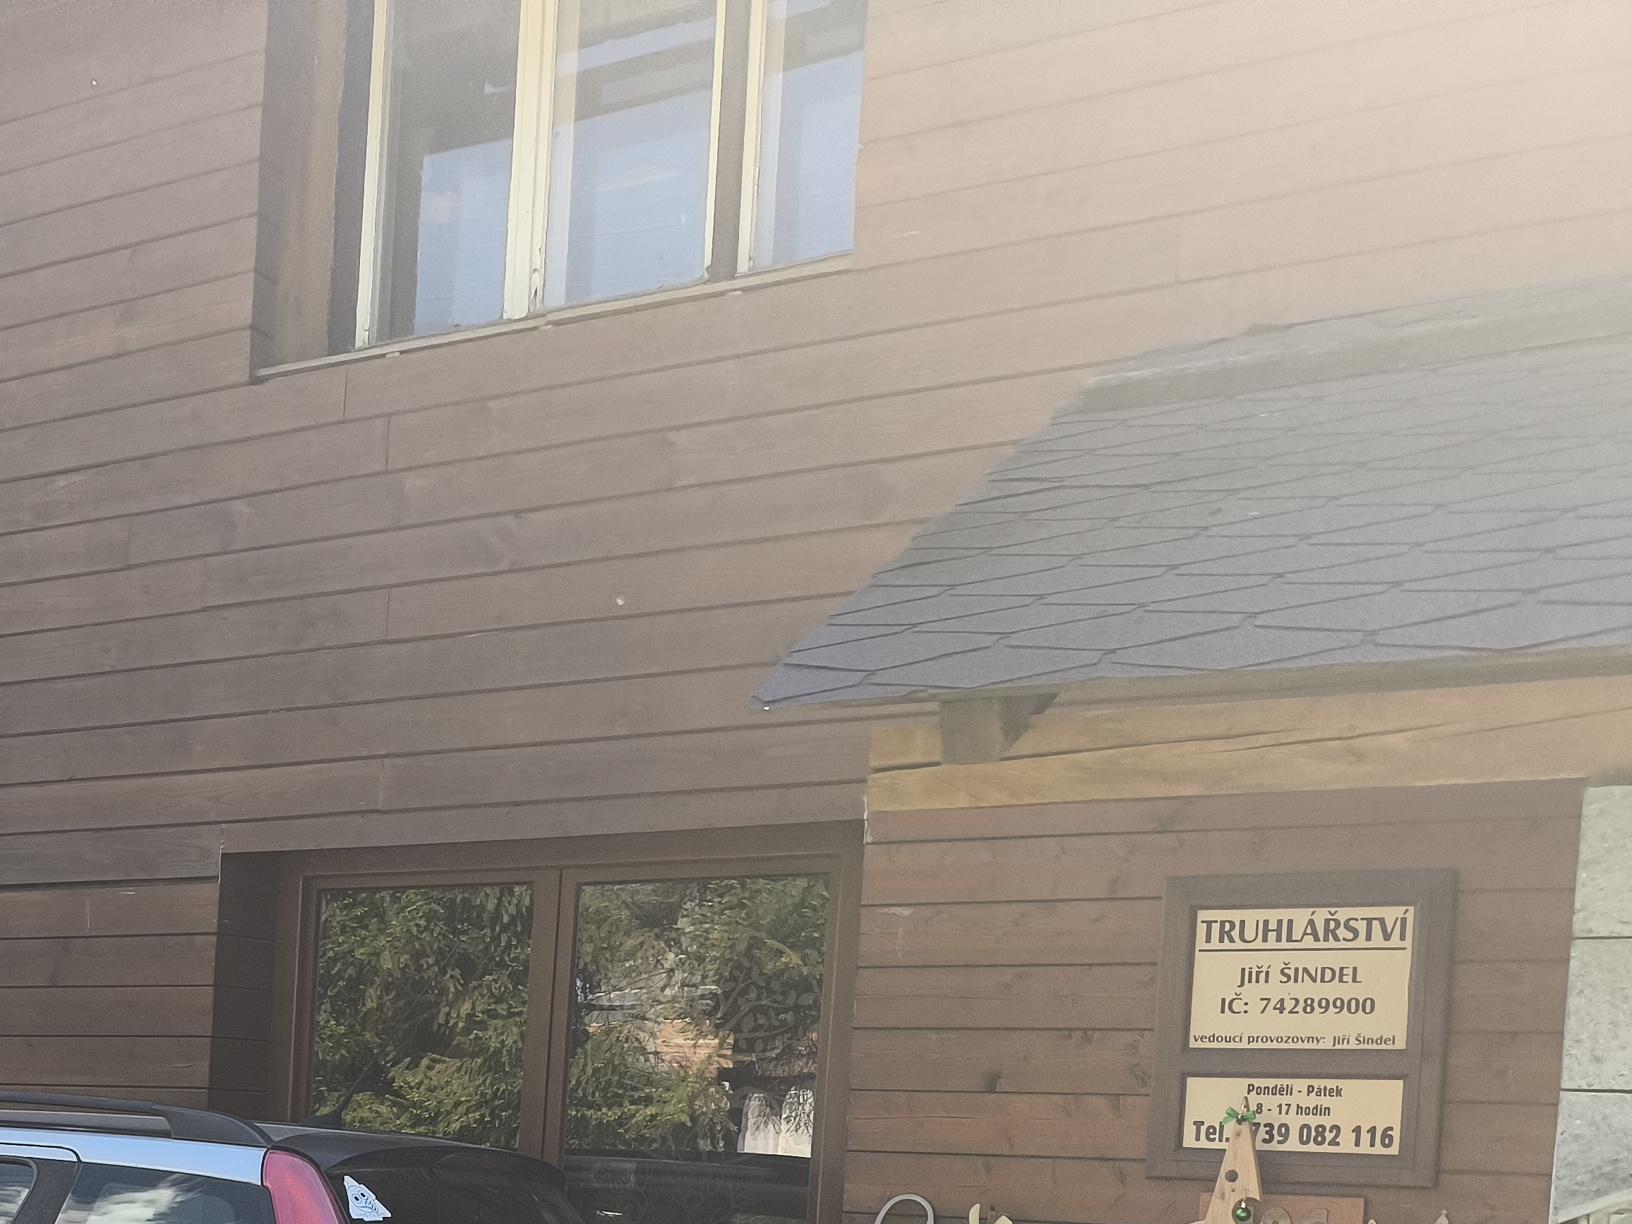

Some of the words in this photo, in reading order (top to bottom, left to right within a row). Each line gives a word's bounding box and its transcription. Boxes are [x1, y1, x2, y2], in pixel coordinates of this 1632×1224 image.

[1200, 908, 1410, 944] TRUHLÁŘSTVÍ
[1237, 964, 1271, 988] Jiří
[1278, 962, 1364, 984] ŠINDEL
[1219, 993, 1249, 1015] IČ:
[1259, 996, 1376, 1015] 74289900
[1193, 1033, 1244, 1044] vedoucí
[1247, 1036, 1327, 1046] provozovny:
[1332, 1034, 1351, 1047] Jiří
[1354, 1033, 1396, 1046] Šindel
[1247, 1083, 1294, 1097] Pondělí
[1306, 1084, 1343, 1099] Pátek
[1255, 1102, 1264, 1115] 8
[1276, 1103, 1292, 1115] 17
[1296, 1104, 1331, 1117] hodin
[1193, 1120, 1231, 1143] Tel.
[1298, 1124, 1342, 1147] 082
[1351, 1126, 1394, 1149] 116
